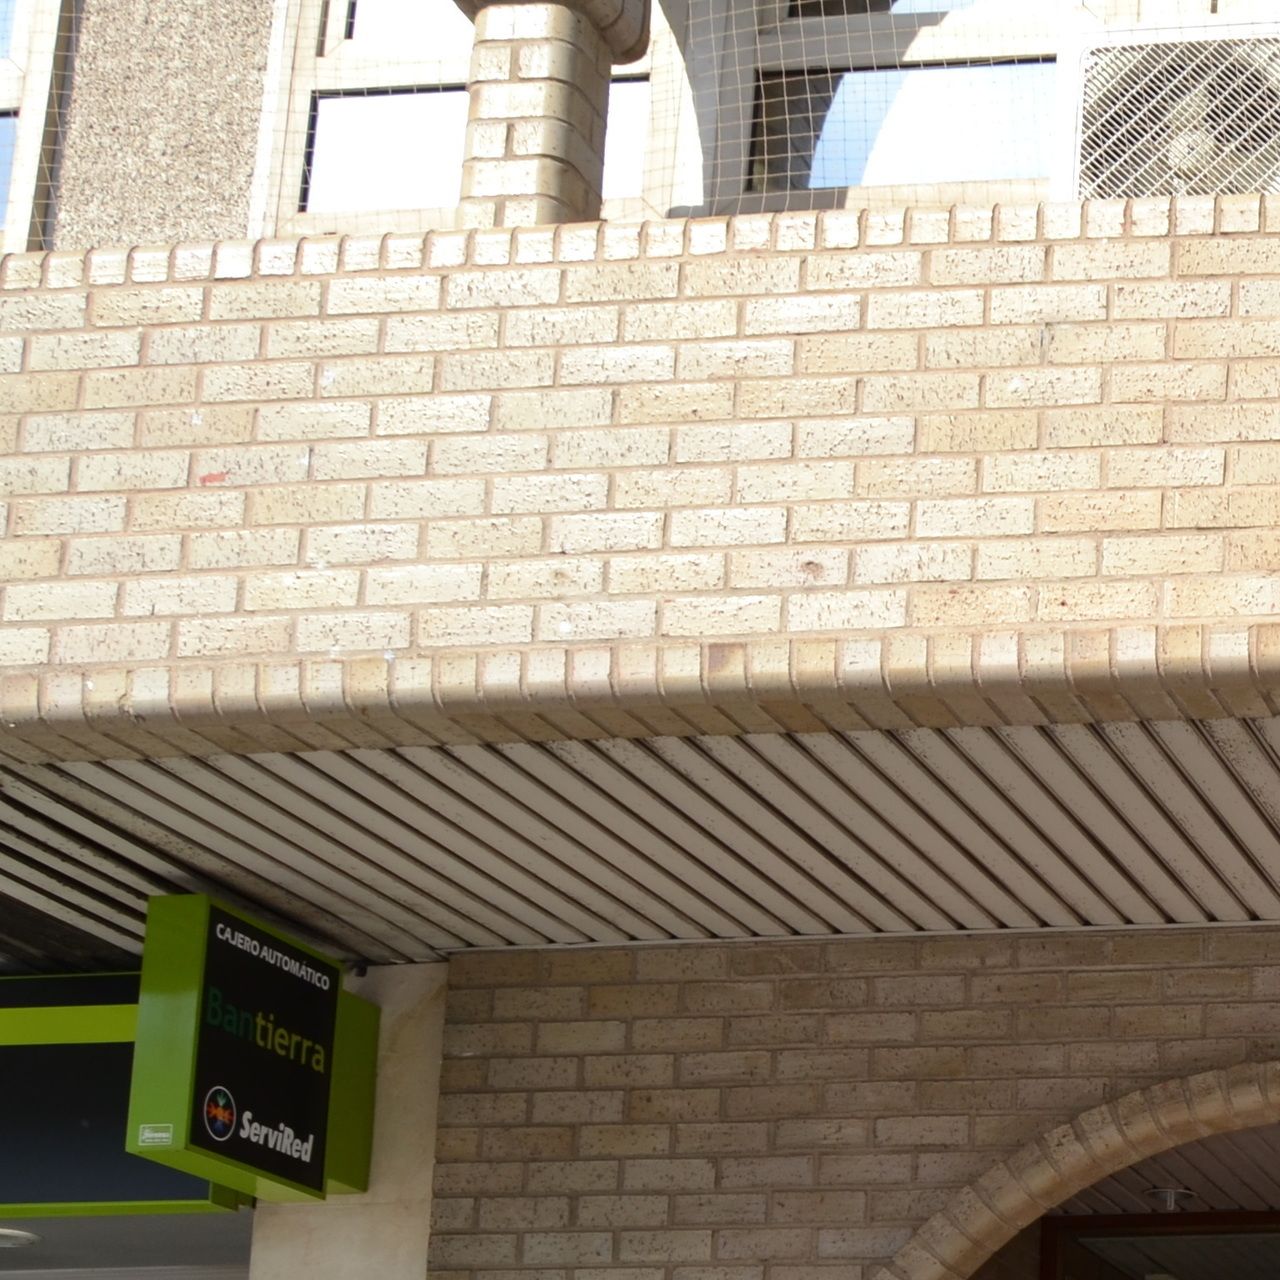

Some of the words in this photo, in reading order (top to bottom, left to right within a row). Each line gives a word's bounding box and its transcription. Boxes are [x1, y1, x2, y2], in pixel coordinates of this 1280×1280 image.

[216, 923, 260, 957] CAJERO
[261, 945, 330, 991] AUTOMÁTICO
[206, 986, 325, 1074] Bantierra
[239, 1111, 314, 1164] ServiRed
